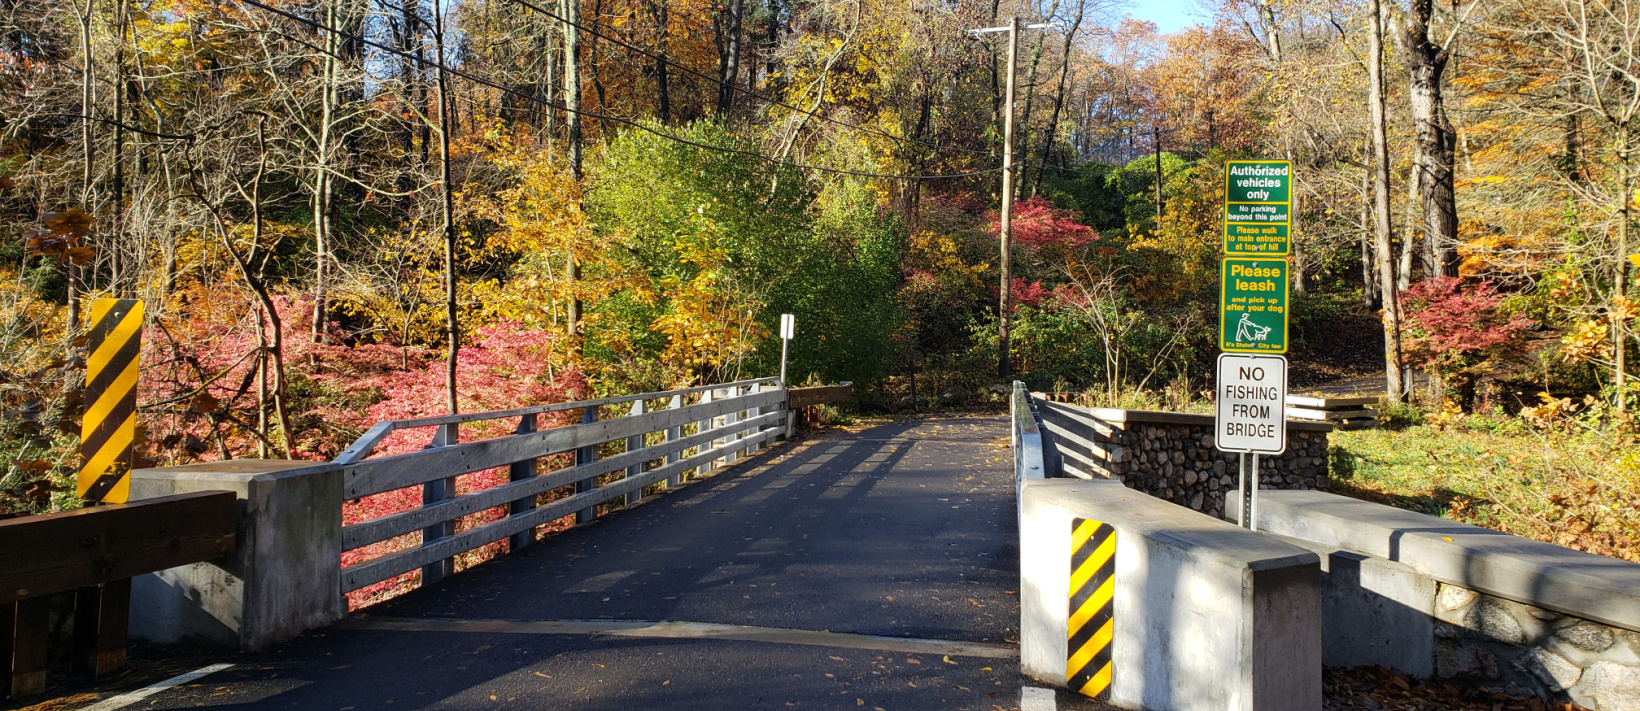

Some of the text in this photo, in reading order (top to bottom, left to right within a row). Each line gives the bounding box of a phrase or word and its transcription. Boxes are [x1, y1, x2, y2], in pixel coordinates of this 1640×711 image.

[1230, 166, 1288, 175] Authorized
[1237, 178, 1280, 187] vehicles
[1247, 189, 1269, 200] only
[1231, 265, 1280, 277] Please
[1236, 279, 1275, 291] leash
[1240, 367, 1264, 381] NO
[1226, 385, 1277, 400] FISHING
[1233, 404, 1269, 418] FROM
[1227, 423, 1274, 438] BRIDGE
